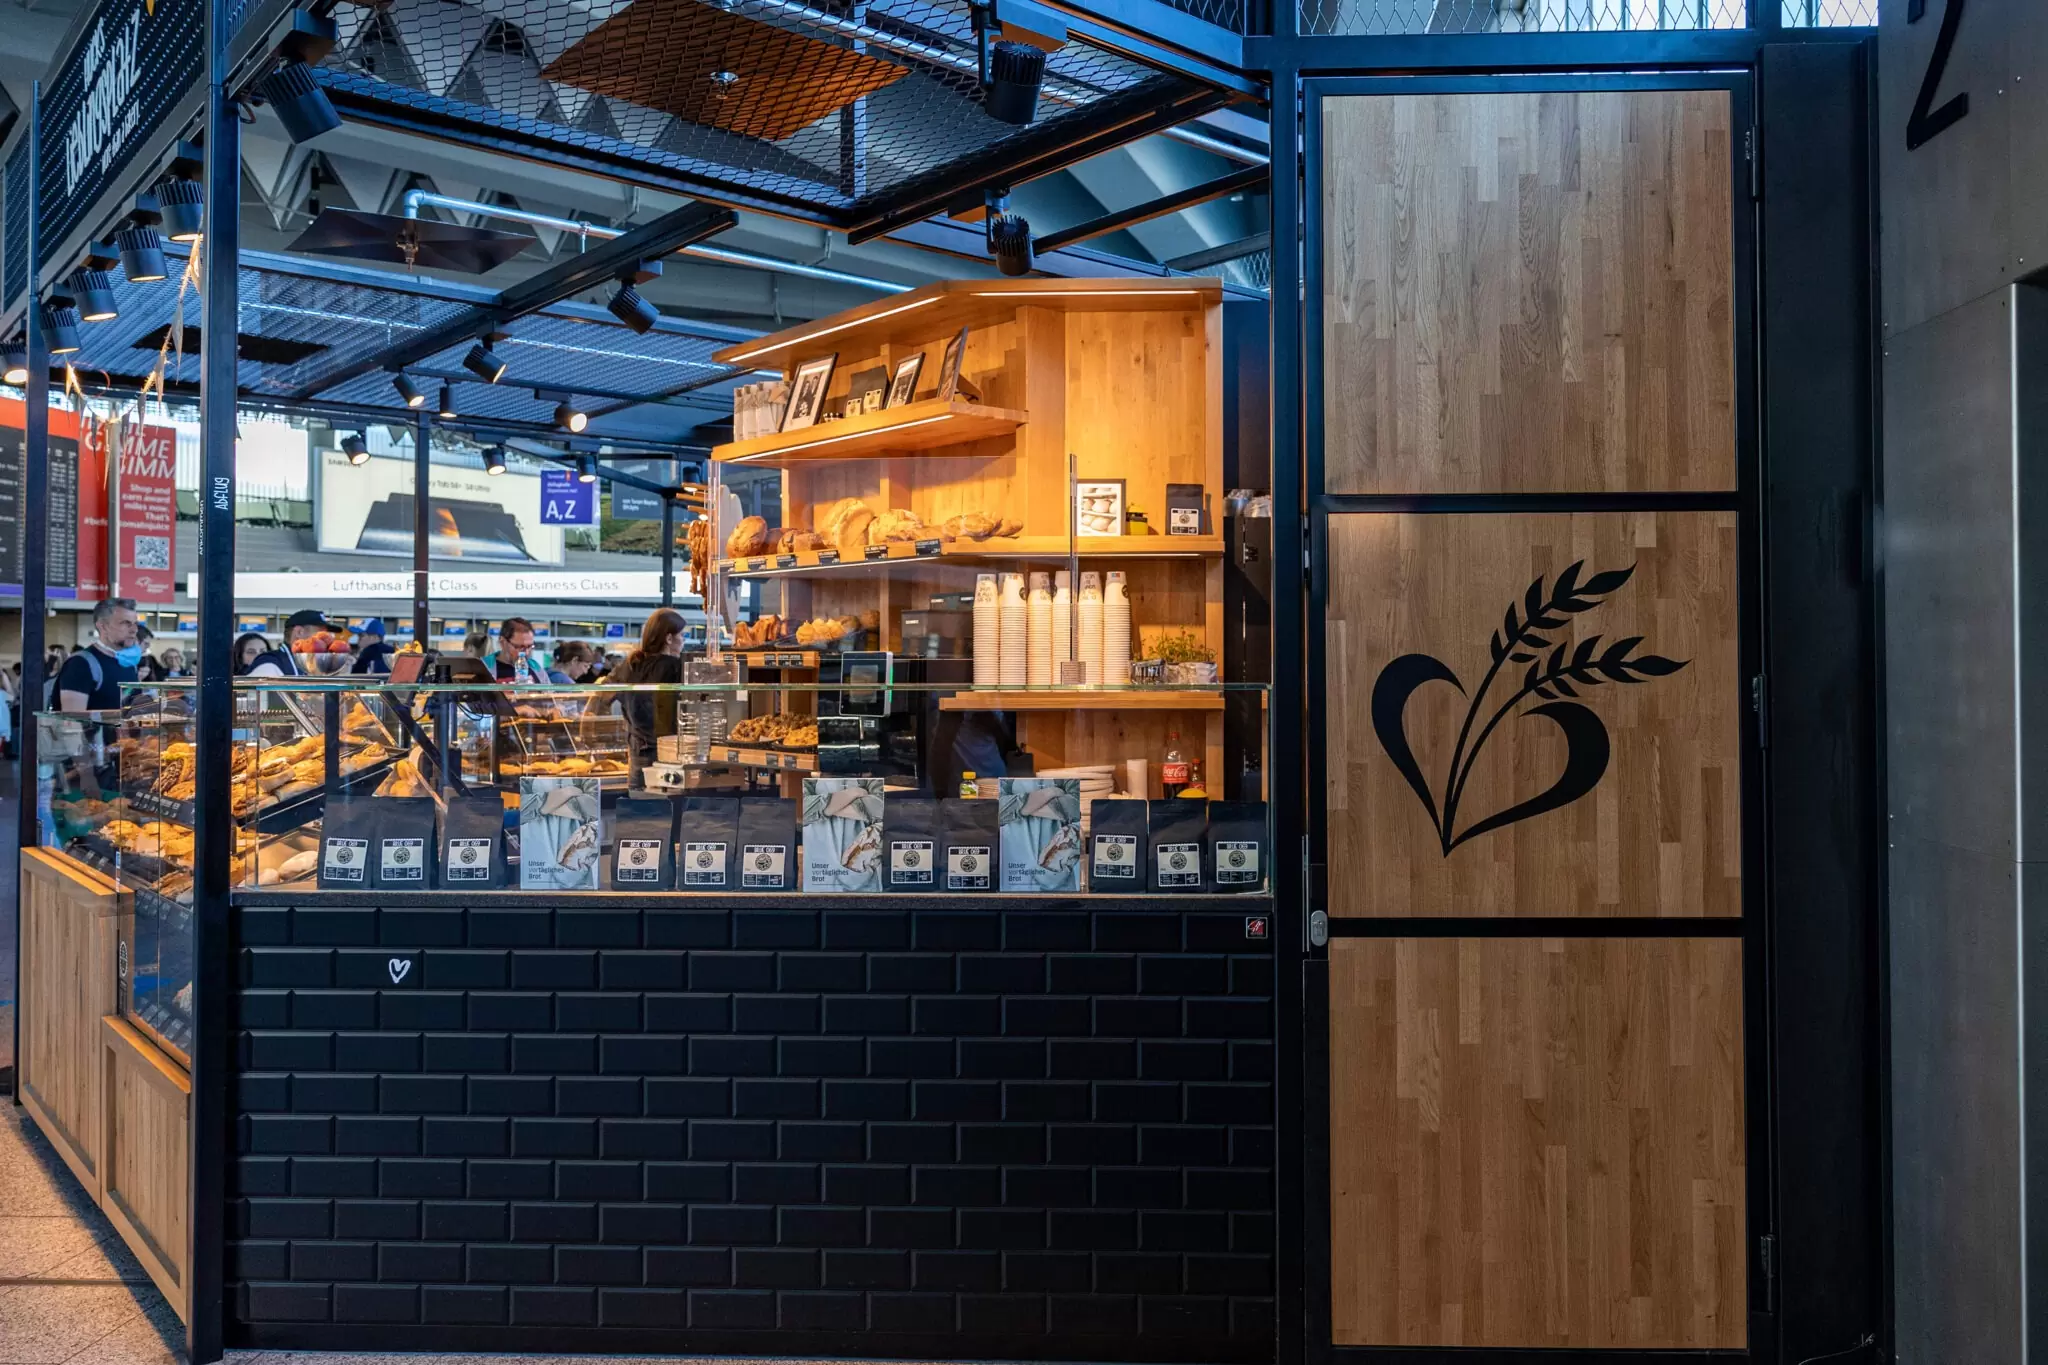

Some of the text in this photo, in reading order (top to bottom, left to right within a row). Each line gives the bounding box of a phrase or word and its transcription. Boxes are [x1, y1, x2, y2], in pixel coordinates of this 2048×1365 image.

[333, 579, 402, 592] Lufthansa
[439, 579, 478, 591] Class
[515, 578, 619, 591] Business Class
[528, 866, 565, 875] vortägliches
[811, 868, 849, 877] vortägliches
[1008, 868, 1047, 877] vortägliches
